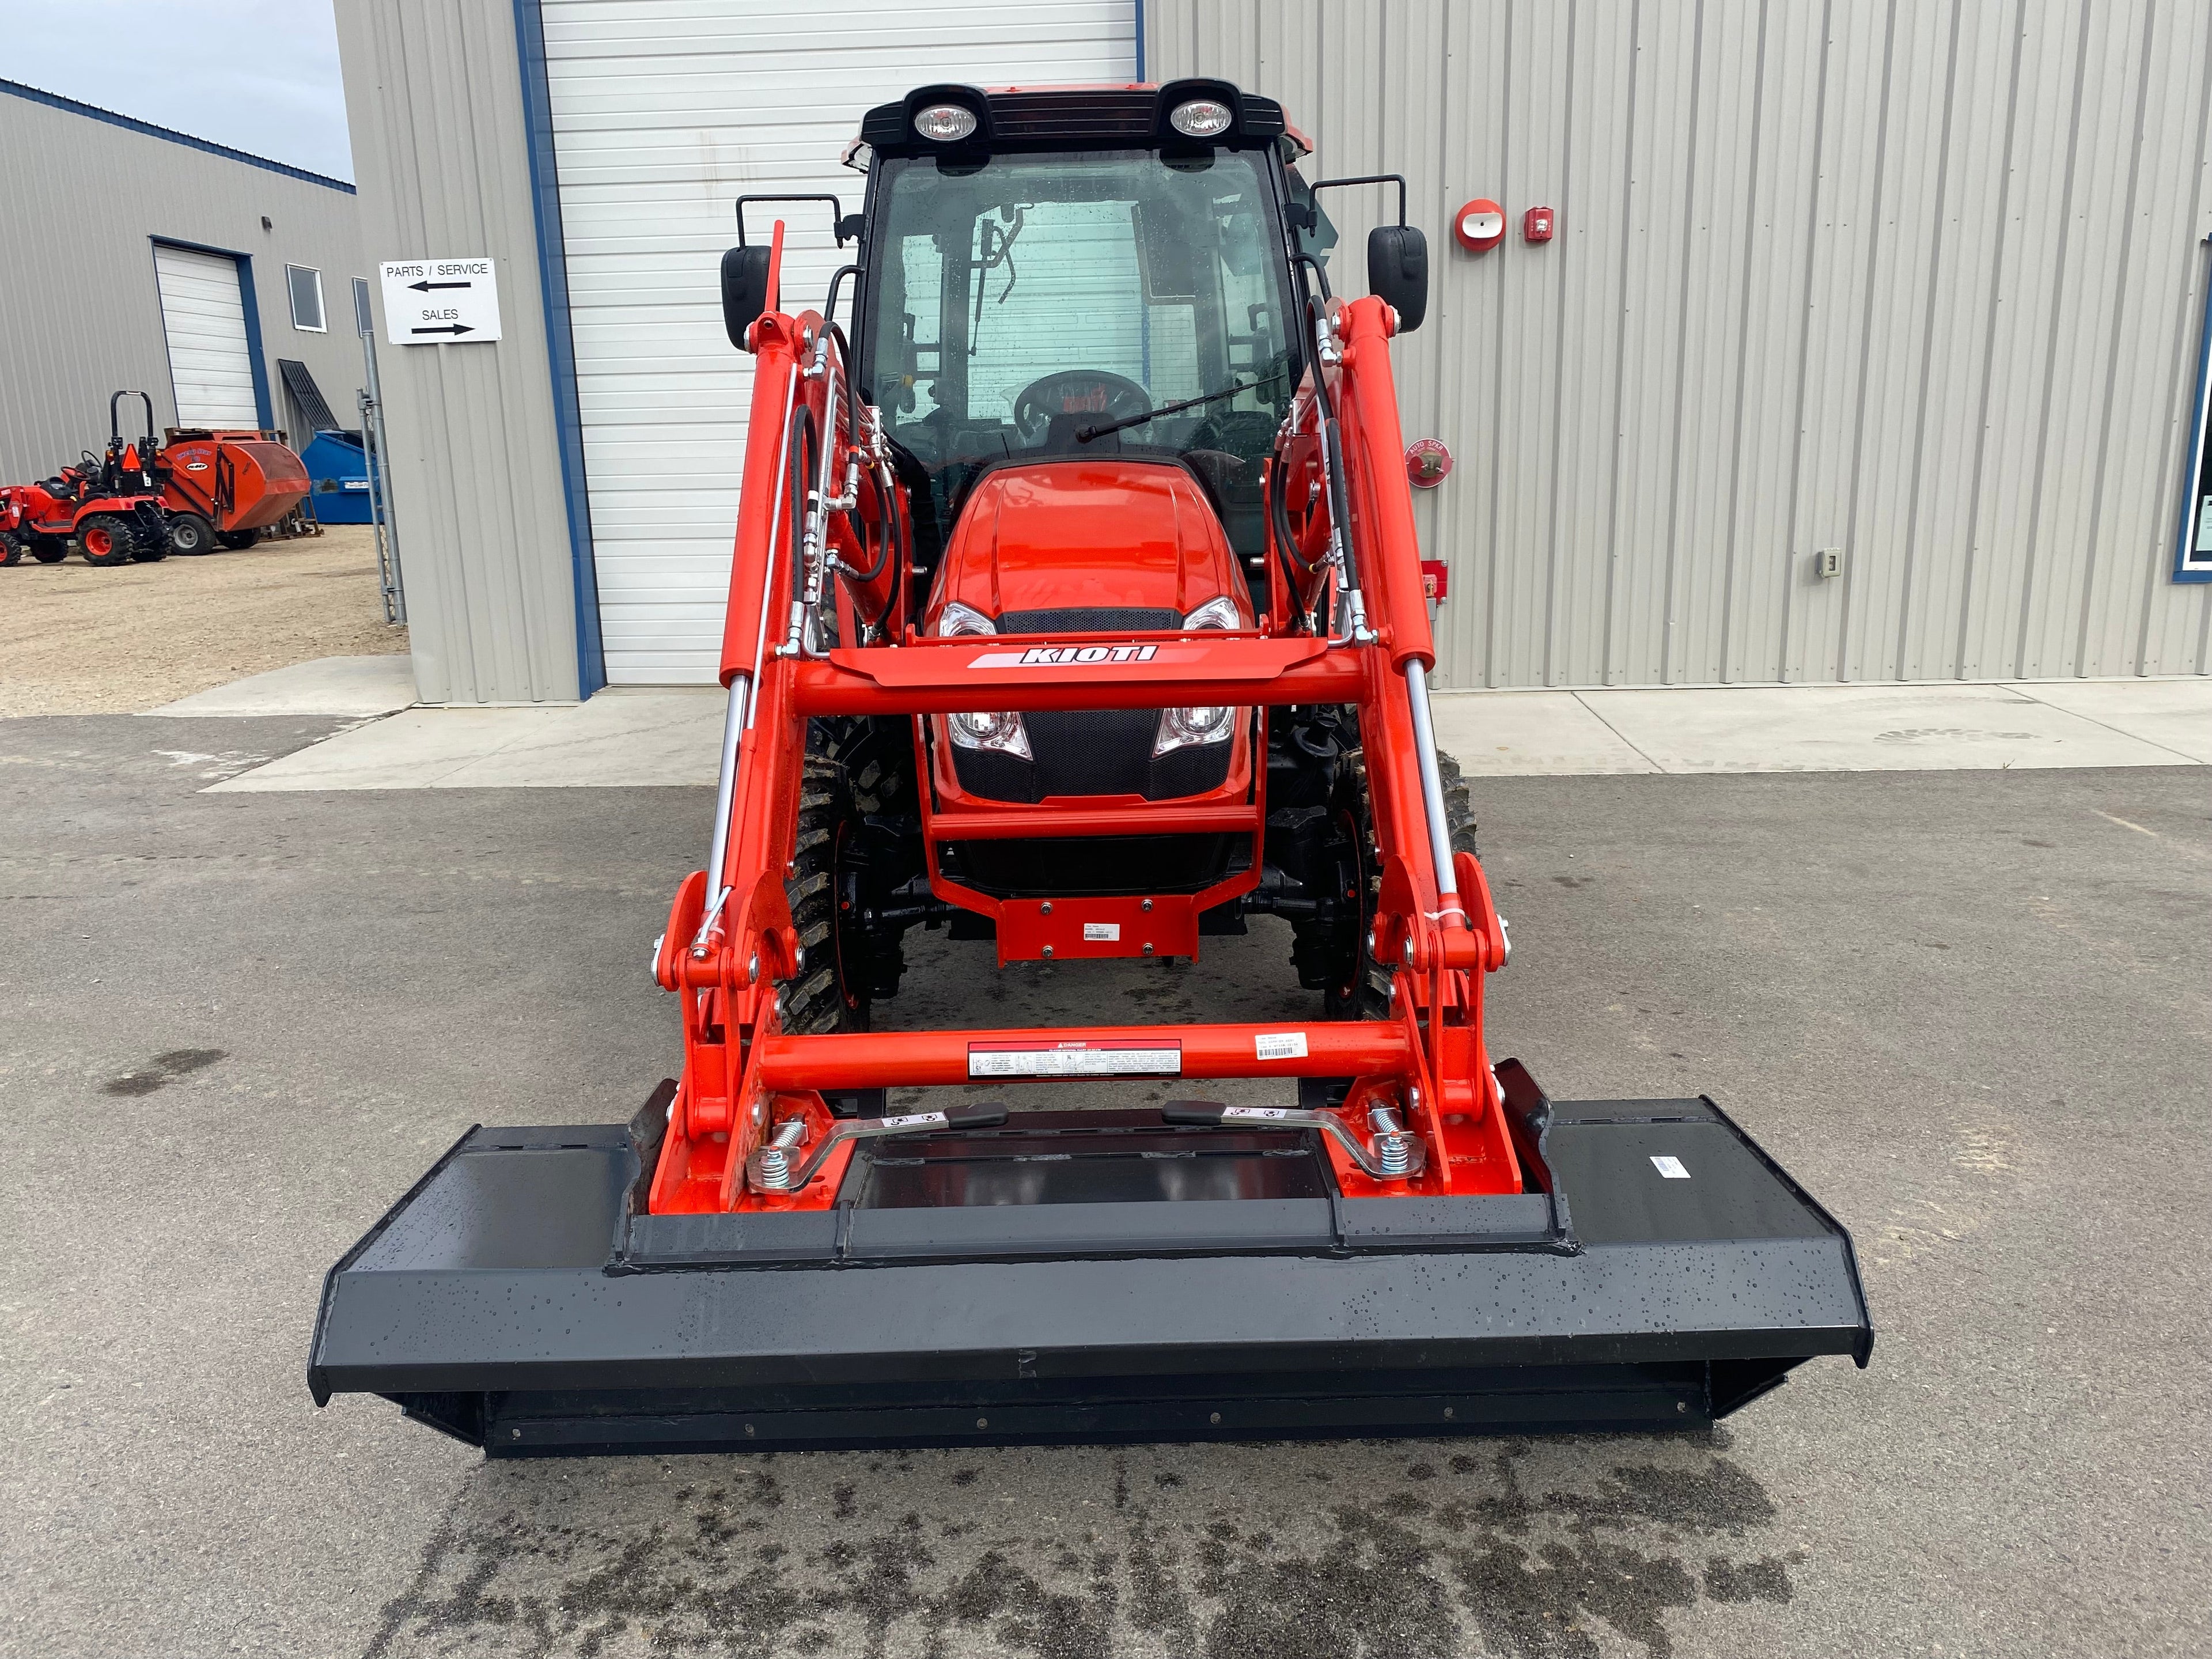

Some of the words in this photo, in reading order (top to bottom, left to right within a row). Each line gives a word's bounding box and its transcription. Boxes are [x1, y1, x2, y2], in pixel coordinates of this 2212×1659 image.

[387, 266, 423, 277] PARTS
[429, 266, 432, 276] /
[437, 264, 488, 275] SERVICE
[422, 309, 459, 320] SALES
[1409, 441, 1425, 454] AUTO
[1428, 440, 1444, 451] SPKR
[1018, 645, 1160, 664] KIOTI
